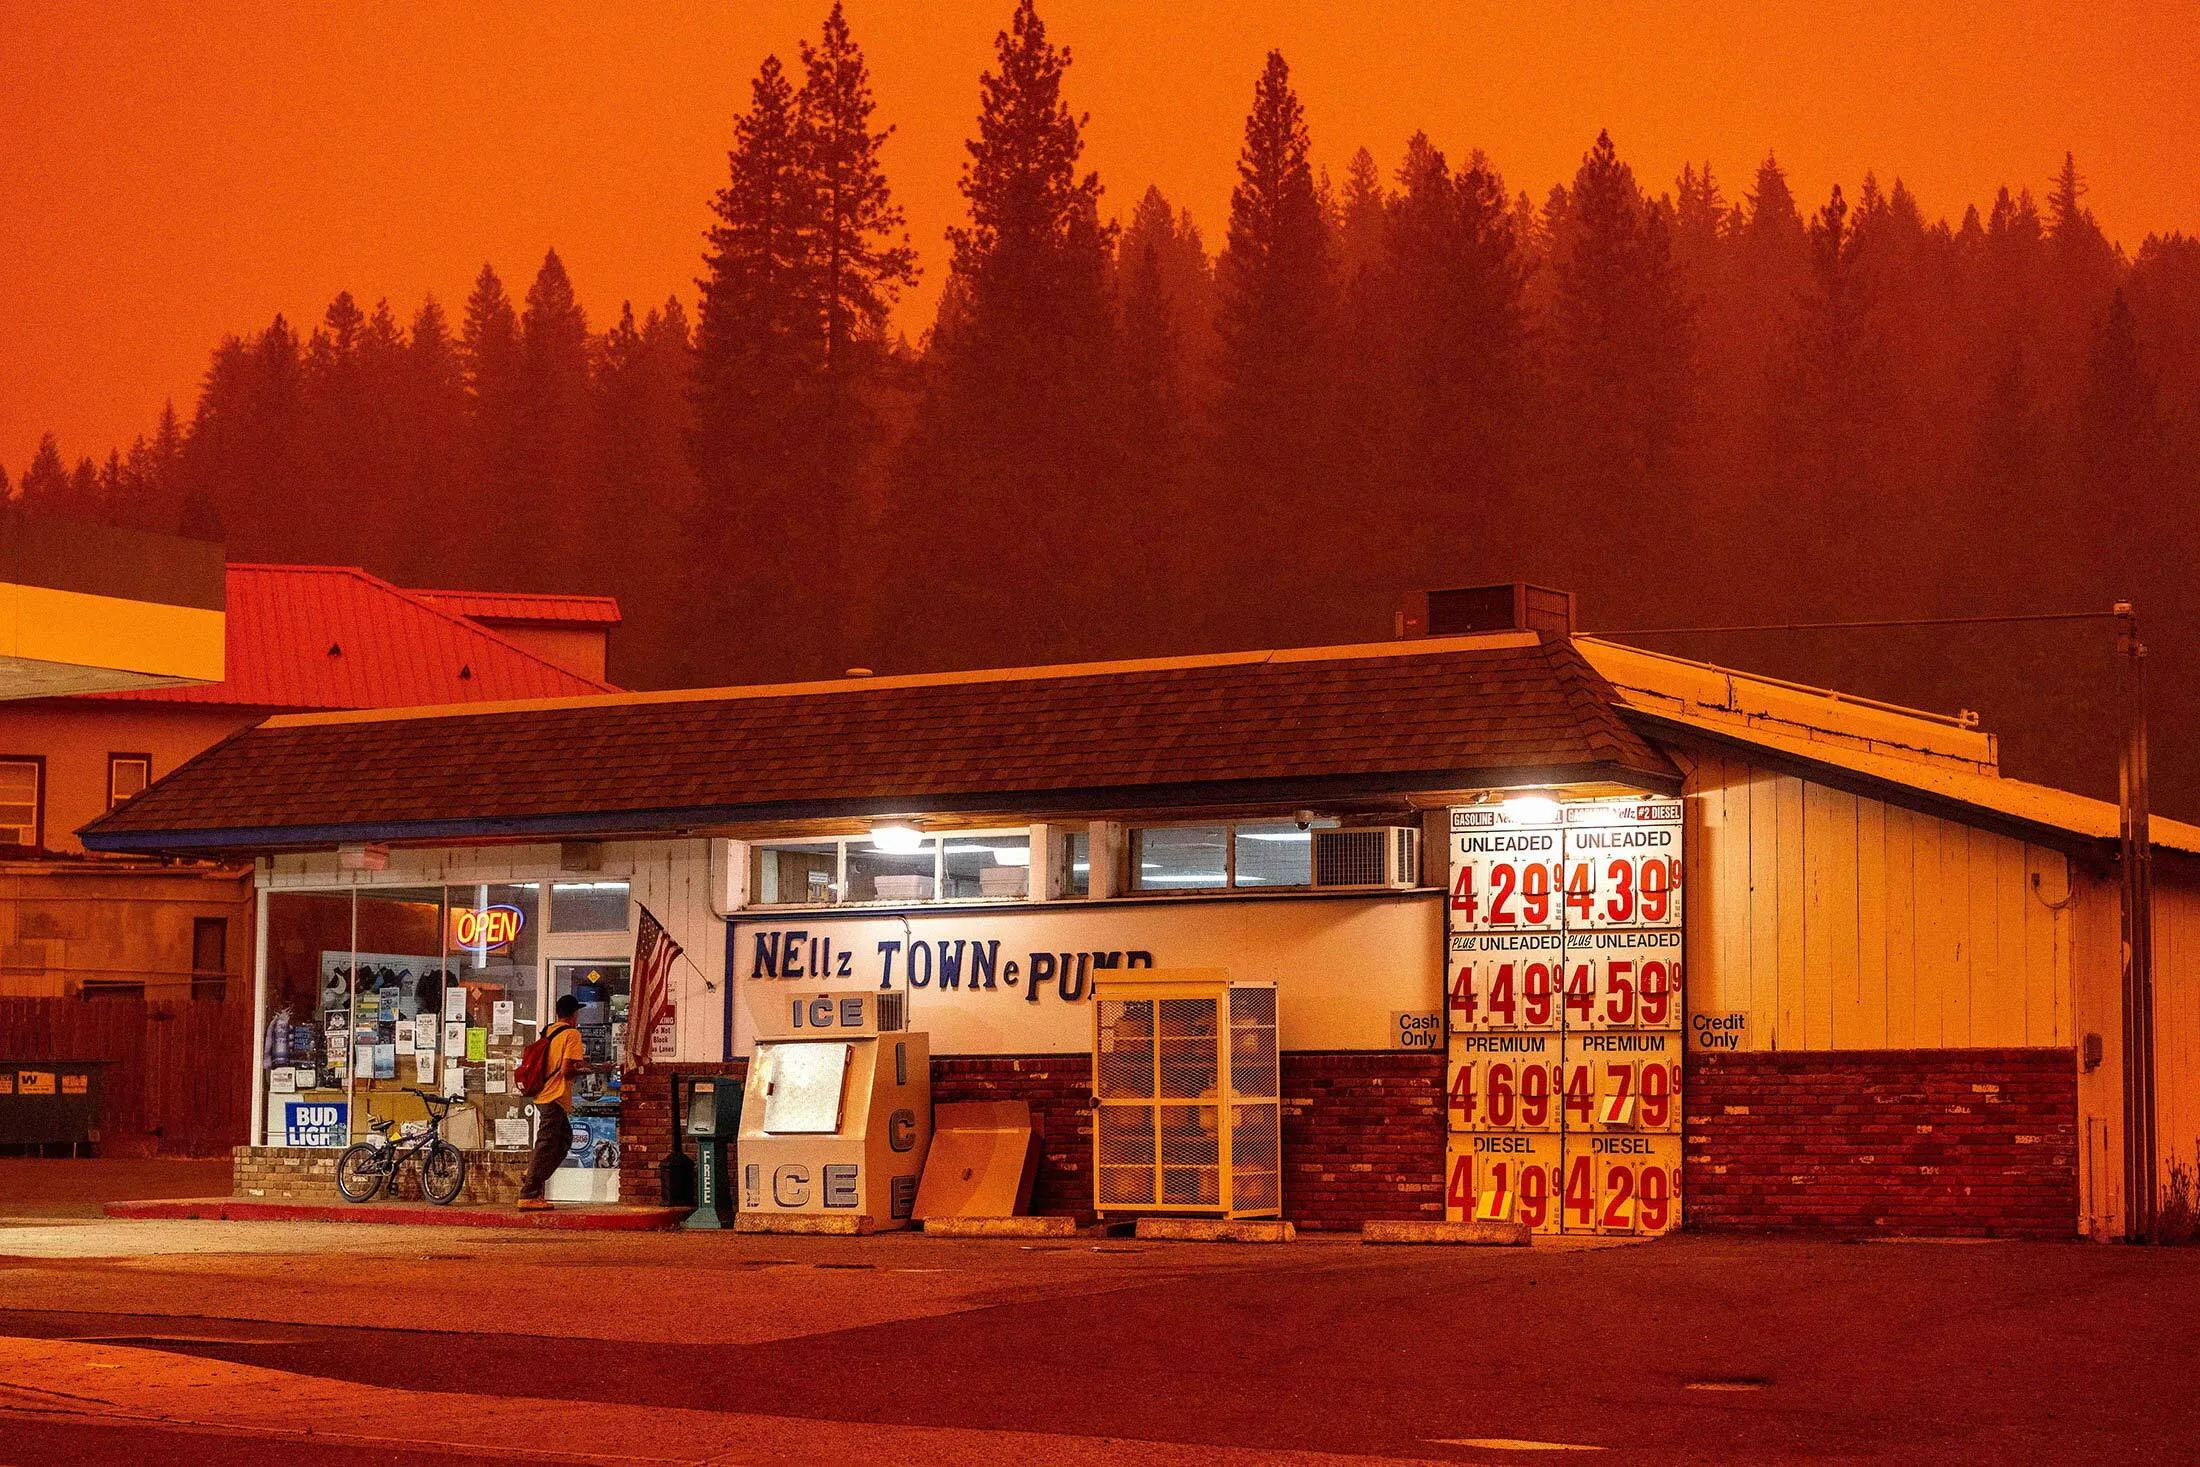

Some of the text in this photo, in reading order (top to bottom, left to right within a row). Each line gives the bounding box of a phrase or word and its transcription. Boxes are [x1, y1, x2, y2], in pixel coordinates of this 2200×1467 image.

[1454, 813, 1493, 826] GASOLINE
[1638, 806, 1650, 820] #2
[1652, 806, 1680, 819] DIESEL
[1461, 836, 1553, 852] UNLEADED
[1576, 831, 1671, 848] UNLEADED
[457, 912, 518, 943] OPEN
[1452, 935, 1562, 951] PLUS UNLEADED
[1567, 933, 1680, 949] PLUS UNLEADED
[793, 998, 863, 1028] ICE
[1400, 1014, 1440, 1029] Cash
[1693, 1014, 1745, 1030] Credit
[1402, 1030, 1437, 1048] Only
[1466, 1037, 1545, 1052] PREMIUM
[1583, 1035, 1665, 1051] PREMIUM
[1700, 1031, 1739, 1050] Only
[296, 1107, 338, 1126] BUD
[289, 1126, 330, 1146] LIGH
[889, 1042, 917, 1220] ICE
[1474, 1137, 1536, 1153] DIESEL
[1592, 1138, 1655, 1154] DIESEL
[703, 1151, 711, 1203] FREE
[745, 1164, 859, 1208] ICE
